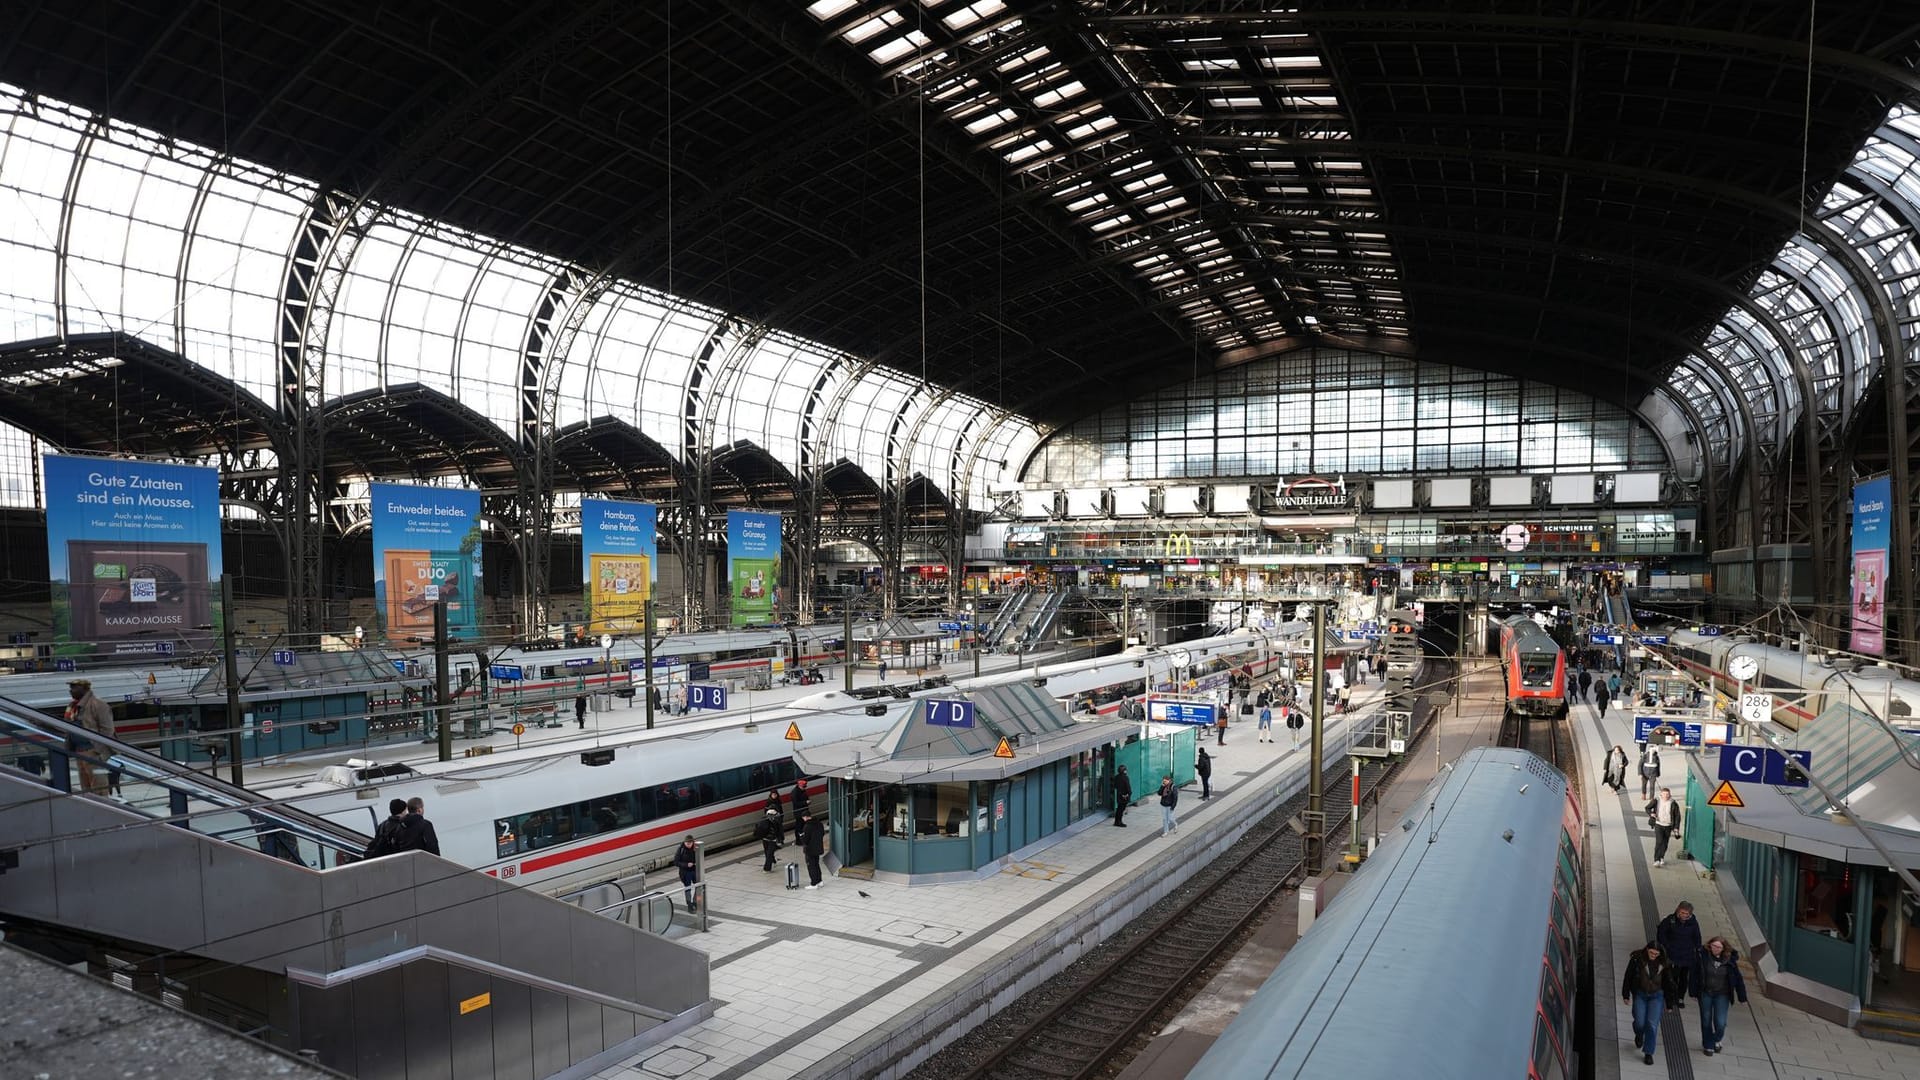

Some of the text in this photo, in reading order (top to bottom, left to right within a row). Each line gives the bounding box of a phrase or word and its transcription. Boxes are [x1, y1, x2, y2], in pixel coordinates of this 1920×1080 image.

[88, 473, 183, 491] Gute Zutaten
[77, 491, 194, 509] sind ein Mousse.
[1276, 496, 1347, 506] WANDELHALLE
[114, 512, 131, 520] Auch
[388, 503, 467, 517] Entweder beides.
[604, 510, 636, 522] Hamburg,
[91, 519, 106, 527] Hier
[108, 520, 122, 528] sind
[124, 520, 142, 528] keine
[143, 521, 169, 529] Aromen
[599, 521, 640, 532] deine Perlen.
[418, 568, 446, 579] DUO
[105, 615, 183, 626] KAKAO-MOUSSE
[1711, 626, 1717, 635] D
[285, 652, 289, 663] D
[694, 687, 721, 705] D 8
[1745, 695, 1770, 707] 286
[929, 701, 964, 721] 7 D
[1752, 708, 1761, 719] 6
[1735, 750, 1757, 775] C
[500, 821, 510, 836] 2
[503, 866, 515, 878] DB
